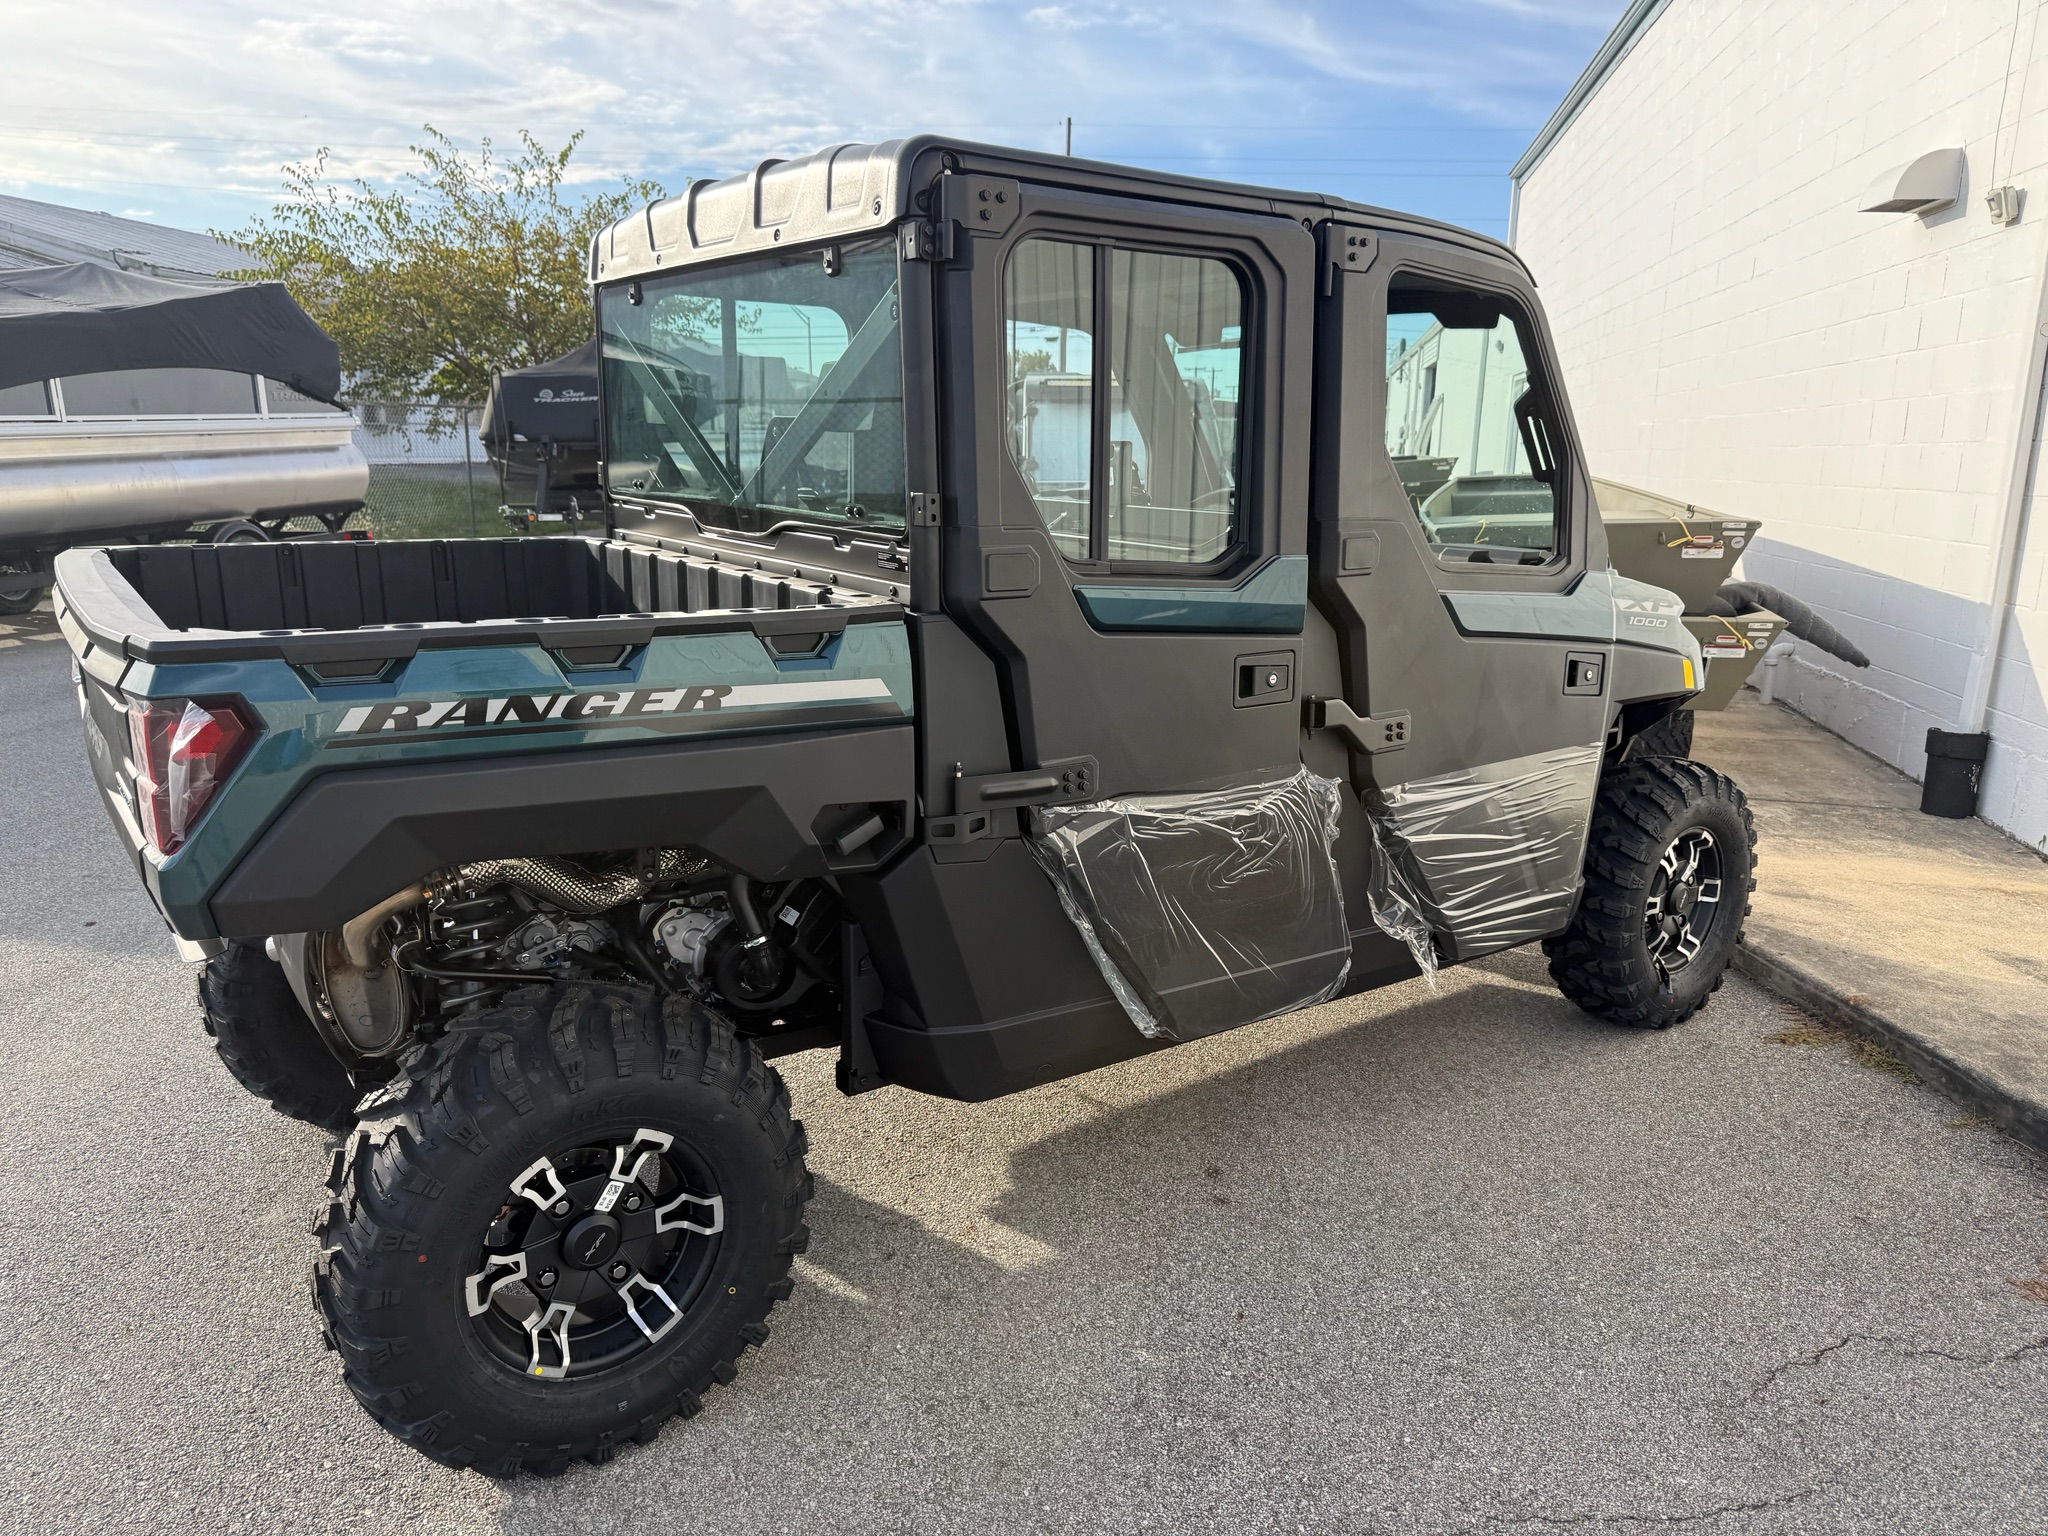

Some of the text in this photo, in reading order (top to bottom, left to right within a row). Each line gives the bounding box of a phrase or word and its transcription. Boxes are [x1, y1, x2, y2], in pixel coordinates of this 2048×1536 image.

[533, 395, 598, 403] TRACKER
[1623, 595, 1674, 612] XP
[1629, 616, 1668, 628] 1000
[356, 684, 733, 735] RANGER
